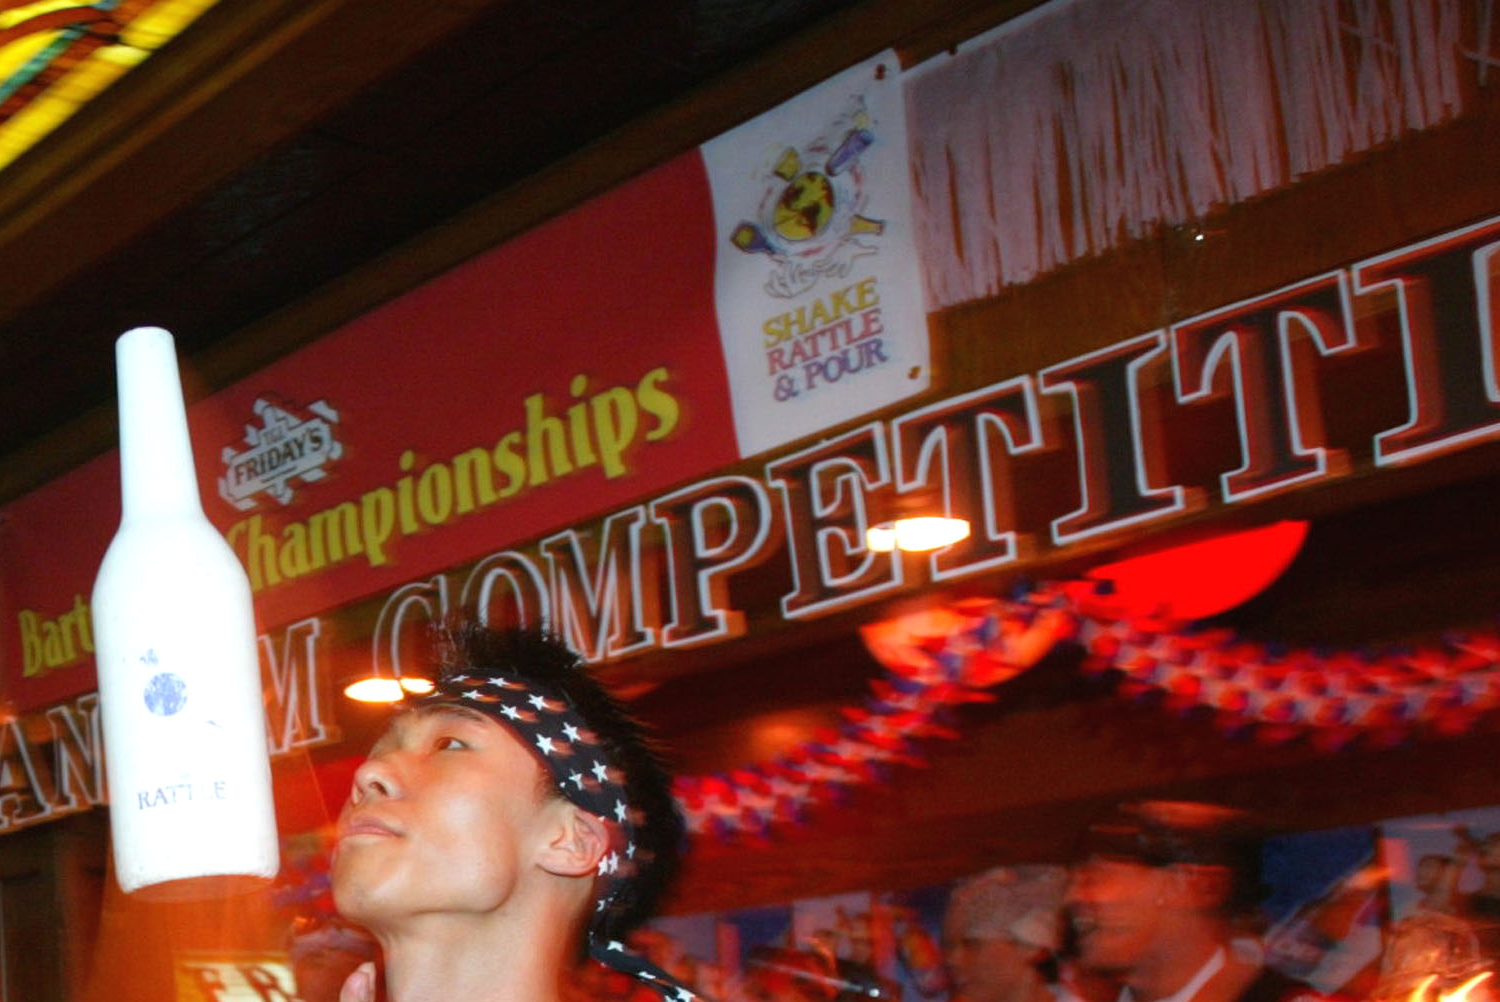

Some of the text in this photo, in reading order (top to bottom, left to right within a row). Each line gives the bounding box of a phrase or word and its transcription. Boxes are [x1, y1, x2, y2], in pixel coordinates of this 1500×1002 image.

[762, 275, 881, 349] SHAKE
[765, 307, 885, 377] RATTLE
[773, 337, 889, 402] & POUR
[233, 426, 324, 486] FRIDAY'S
[137, 780, 228, 811] RATTE
